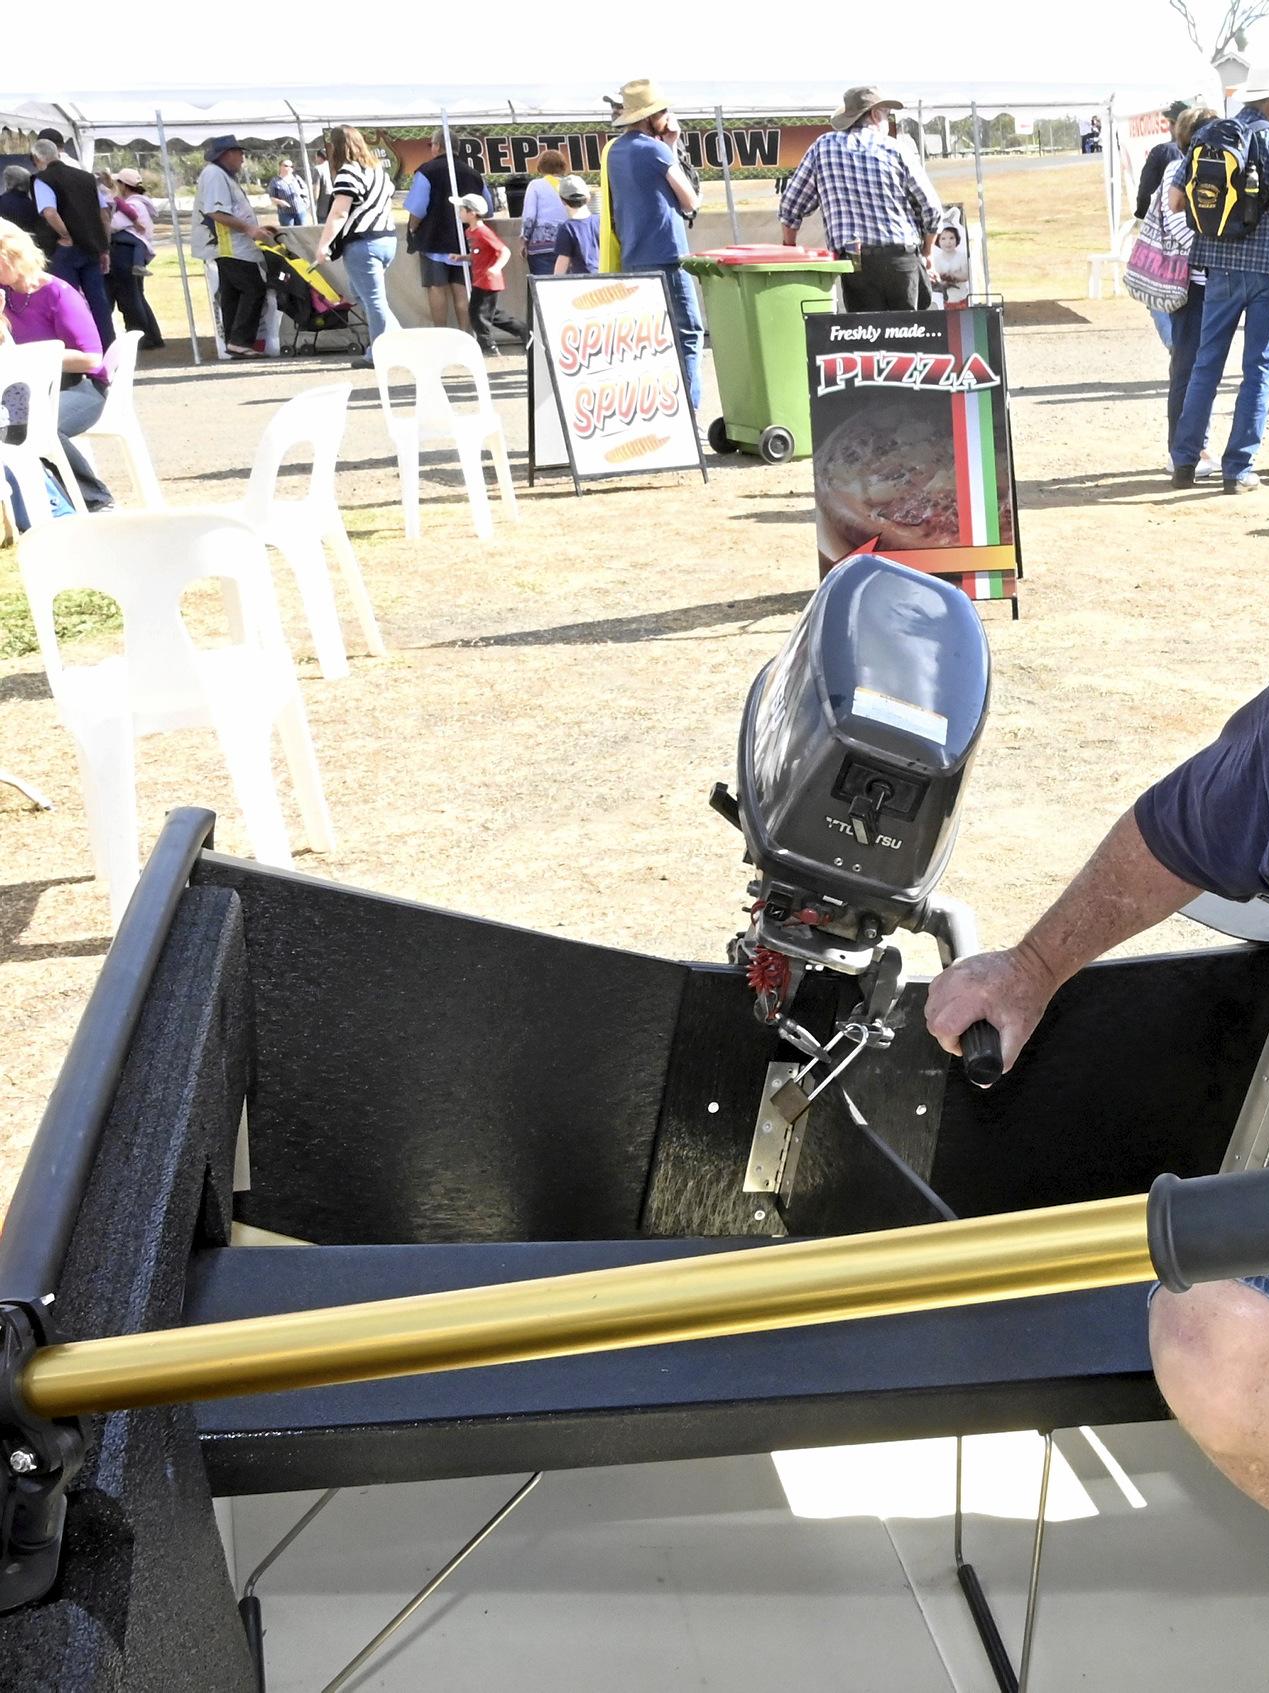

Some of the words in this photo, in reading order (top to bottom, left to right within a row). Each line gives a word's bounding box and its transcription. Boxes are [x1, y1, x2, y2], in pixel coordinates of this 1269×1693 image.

[457, 133, 606, 176] REPTIL
[680, 128, 781, 170] HOW
[559, 312, 673, 376] SPIRAL
[830, 325, 881, 342] Freshly
[885, 324, 942, 339] made...
[816, 350, 1000, 397] PIZZA
